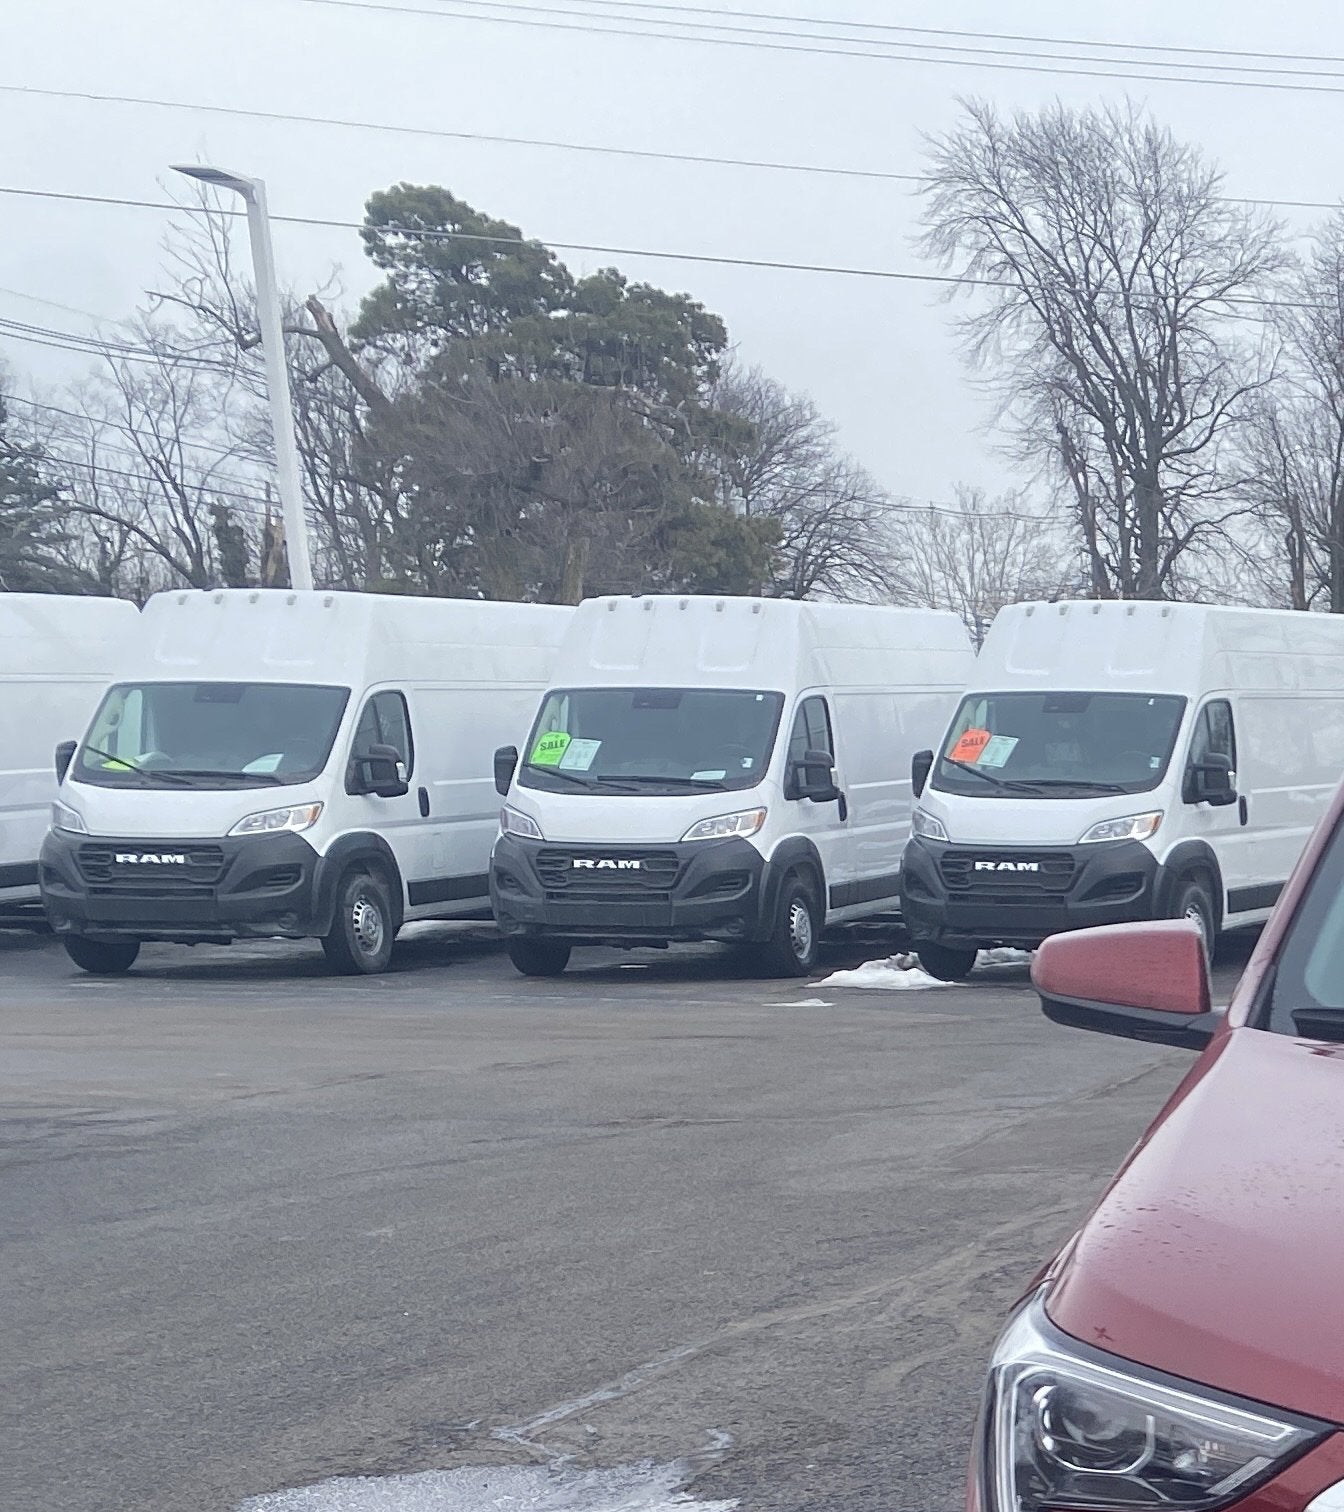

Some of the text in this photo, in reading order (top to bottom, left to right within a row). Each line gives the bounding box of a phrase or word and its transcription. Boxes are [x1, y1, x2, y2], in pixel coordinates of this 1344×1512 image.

[540, 739, 566, 751] SALE
[115, 854, 185, 864] RAM
[573, 859, 641, 869] RAM
[974, 861, 1039, 871] RAM
